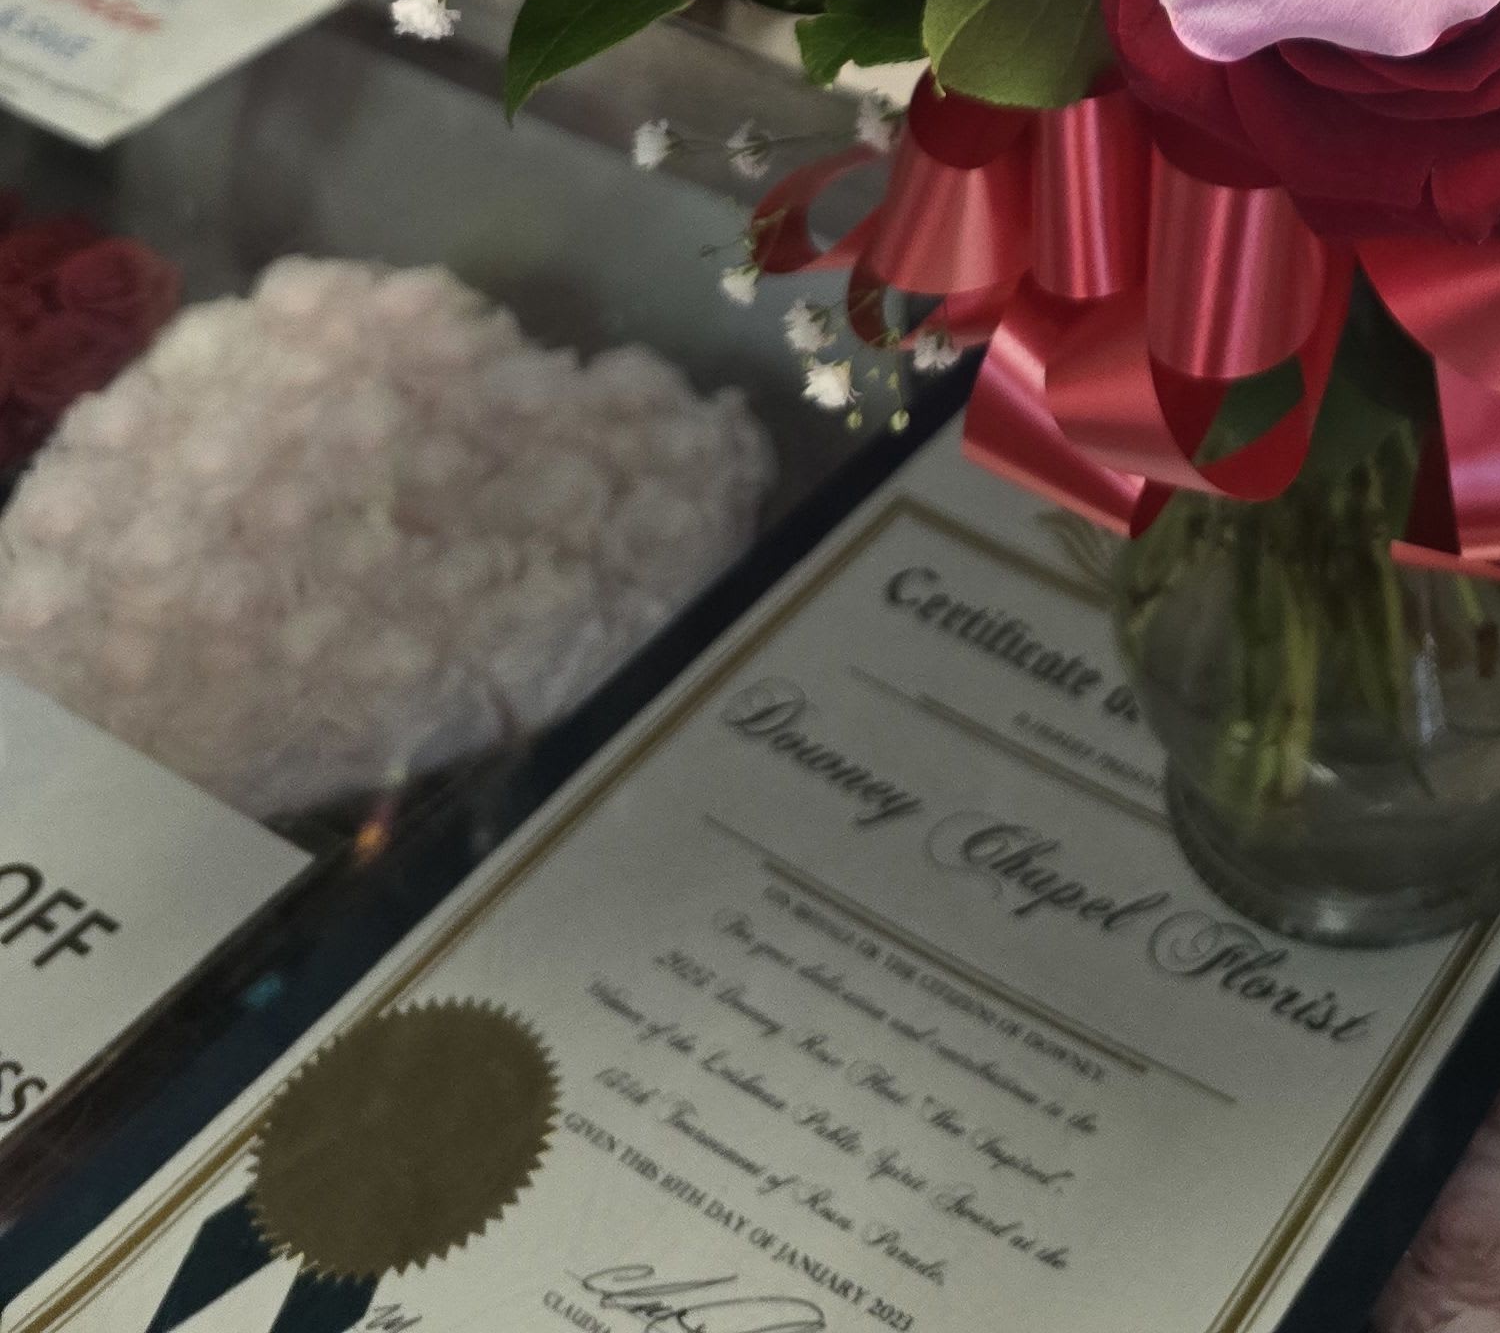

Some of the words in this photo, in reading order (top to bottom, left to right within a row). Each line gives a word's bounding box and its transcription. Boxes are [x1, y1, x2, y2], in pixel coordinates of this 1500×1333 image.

[885, 568, 1102, 696] Certificate
[722, 679, 922, 830] Downey
[928, 811, 1169, 933] Chapel
[1146, 906, 1375, 1043] Florist
[564, 1112, 618, 1153] GIVEN
[619, 1146, 660, 1181] THIS
[659, 1173, 707, 1208] 10TH
[703, 1199, 750, 1234] DAY
[749, 1228, 777, 1250] OF
[772, 1243, 870, 1306] JANUARY
[867, 1296, 914, 1332] 2023
